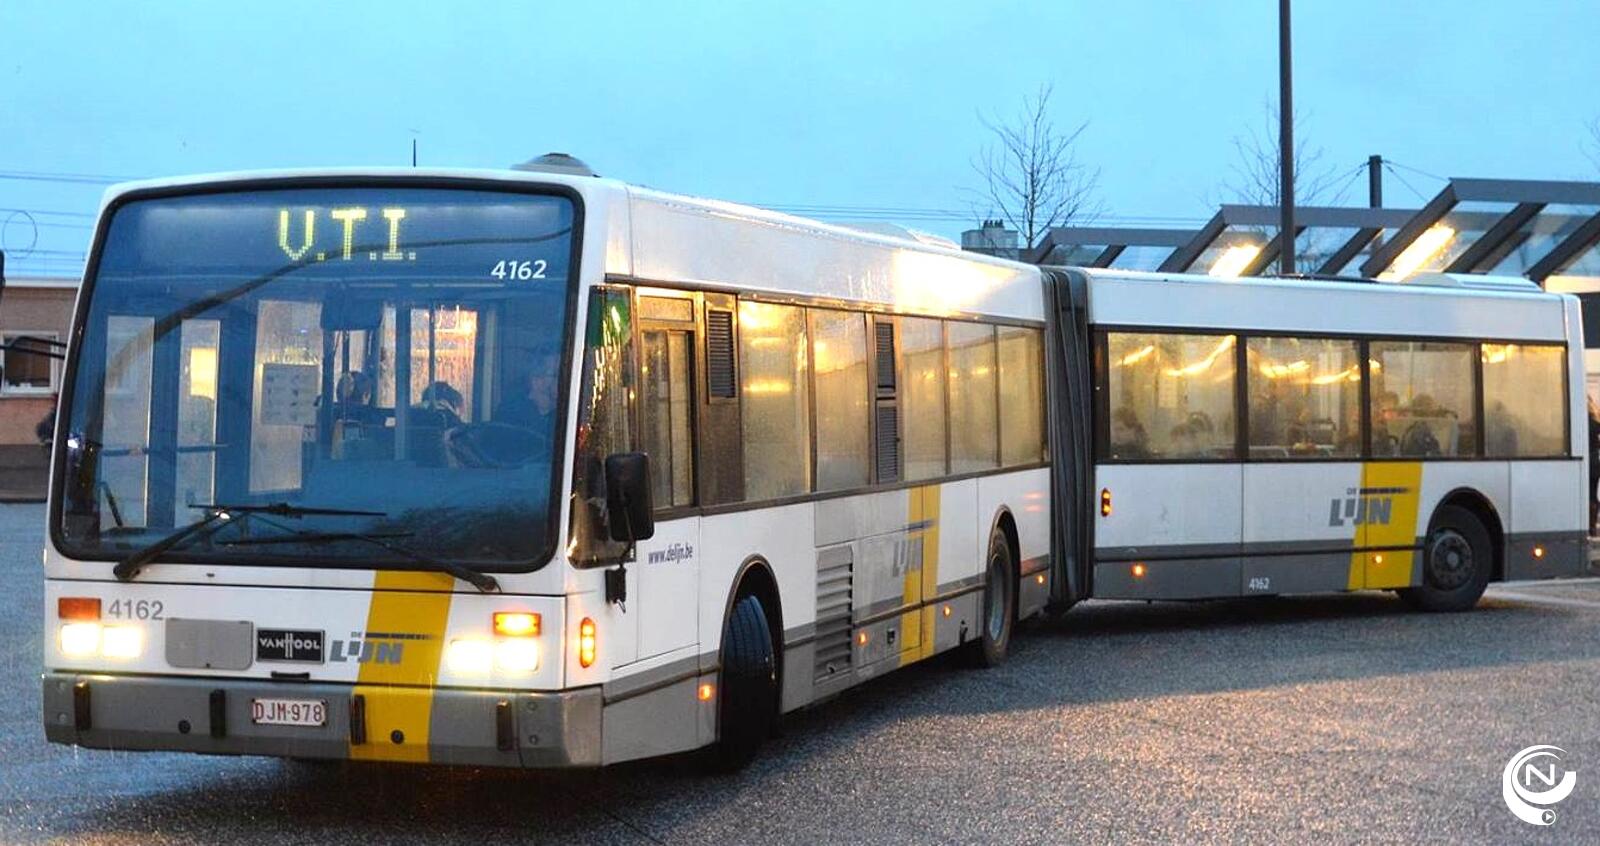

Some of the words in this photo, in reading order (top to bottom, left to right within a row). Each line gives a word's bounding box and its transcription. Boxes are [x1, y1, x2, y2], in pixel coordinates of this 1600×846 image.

[279, 209, 416, 261] V.T.I.
[491, 259, 547, 280] 4162
[1329, 498, 1391, 527] LIJN
[648, 543, 693, 565] www.delijn.be
[1249, 576, 1270, 590] 4162
[108, 598, 163, 621] 4162
[329, 640, 403, 664] LIJN
